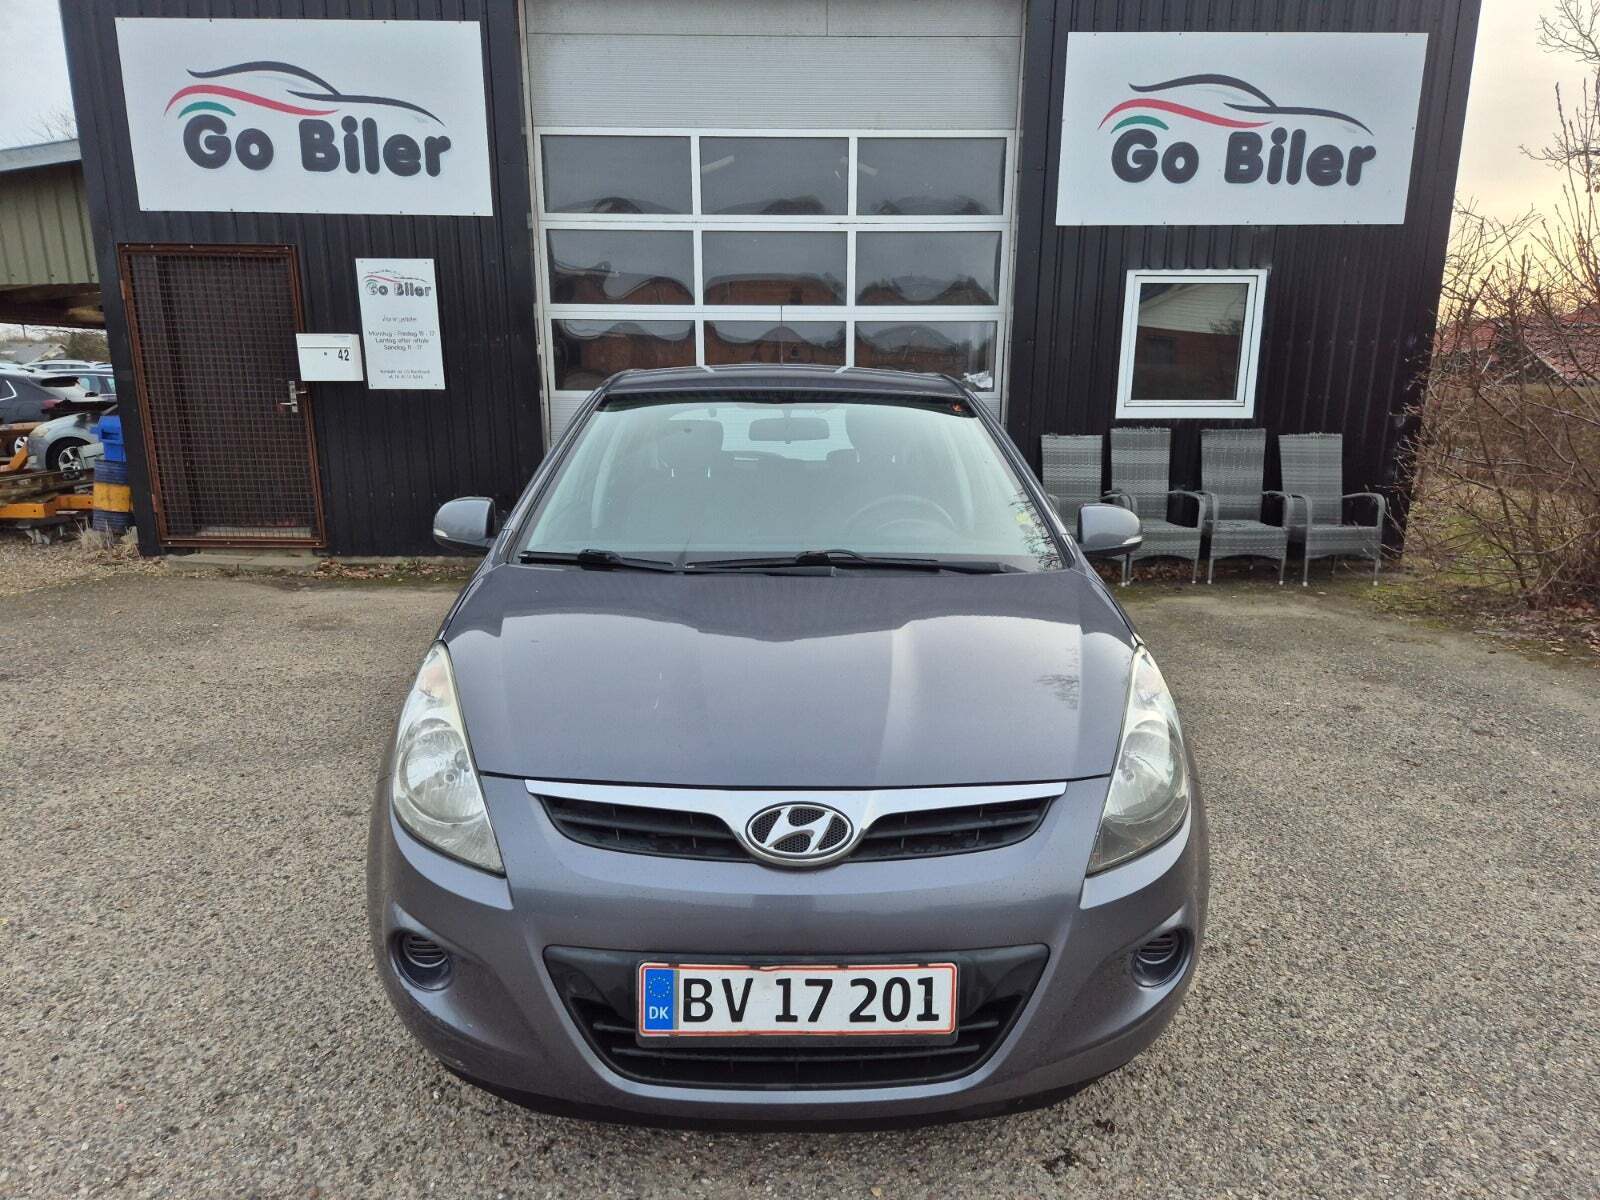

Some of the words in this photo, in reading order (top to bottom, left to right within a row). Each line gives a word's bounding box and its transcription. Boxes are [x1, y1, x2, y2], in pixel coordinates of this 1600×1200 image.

[183, 115, 273, 170] Go
[299, 115, 451, 177] Biler
[1111, 128, 1199, 183] Go
[1224, 127, 1377, 186] Biler
[366, 282, 388, 296] Go
[394, 282, 432, 297] Biler
[338, 348, 350, 361] 42
[649, 1006, 670, 1020] DK
[682, 978, 754, 1022] BV
[775, 978, 833, 1023] 17
[849, 977, 940, 1023] 201
